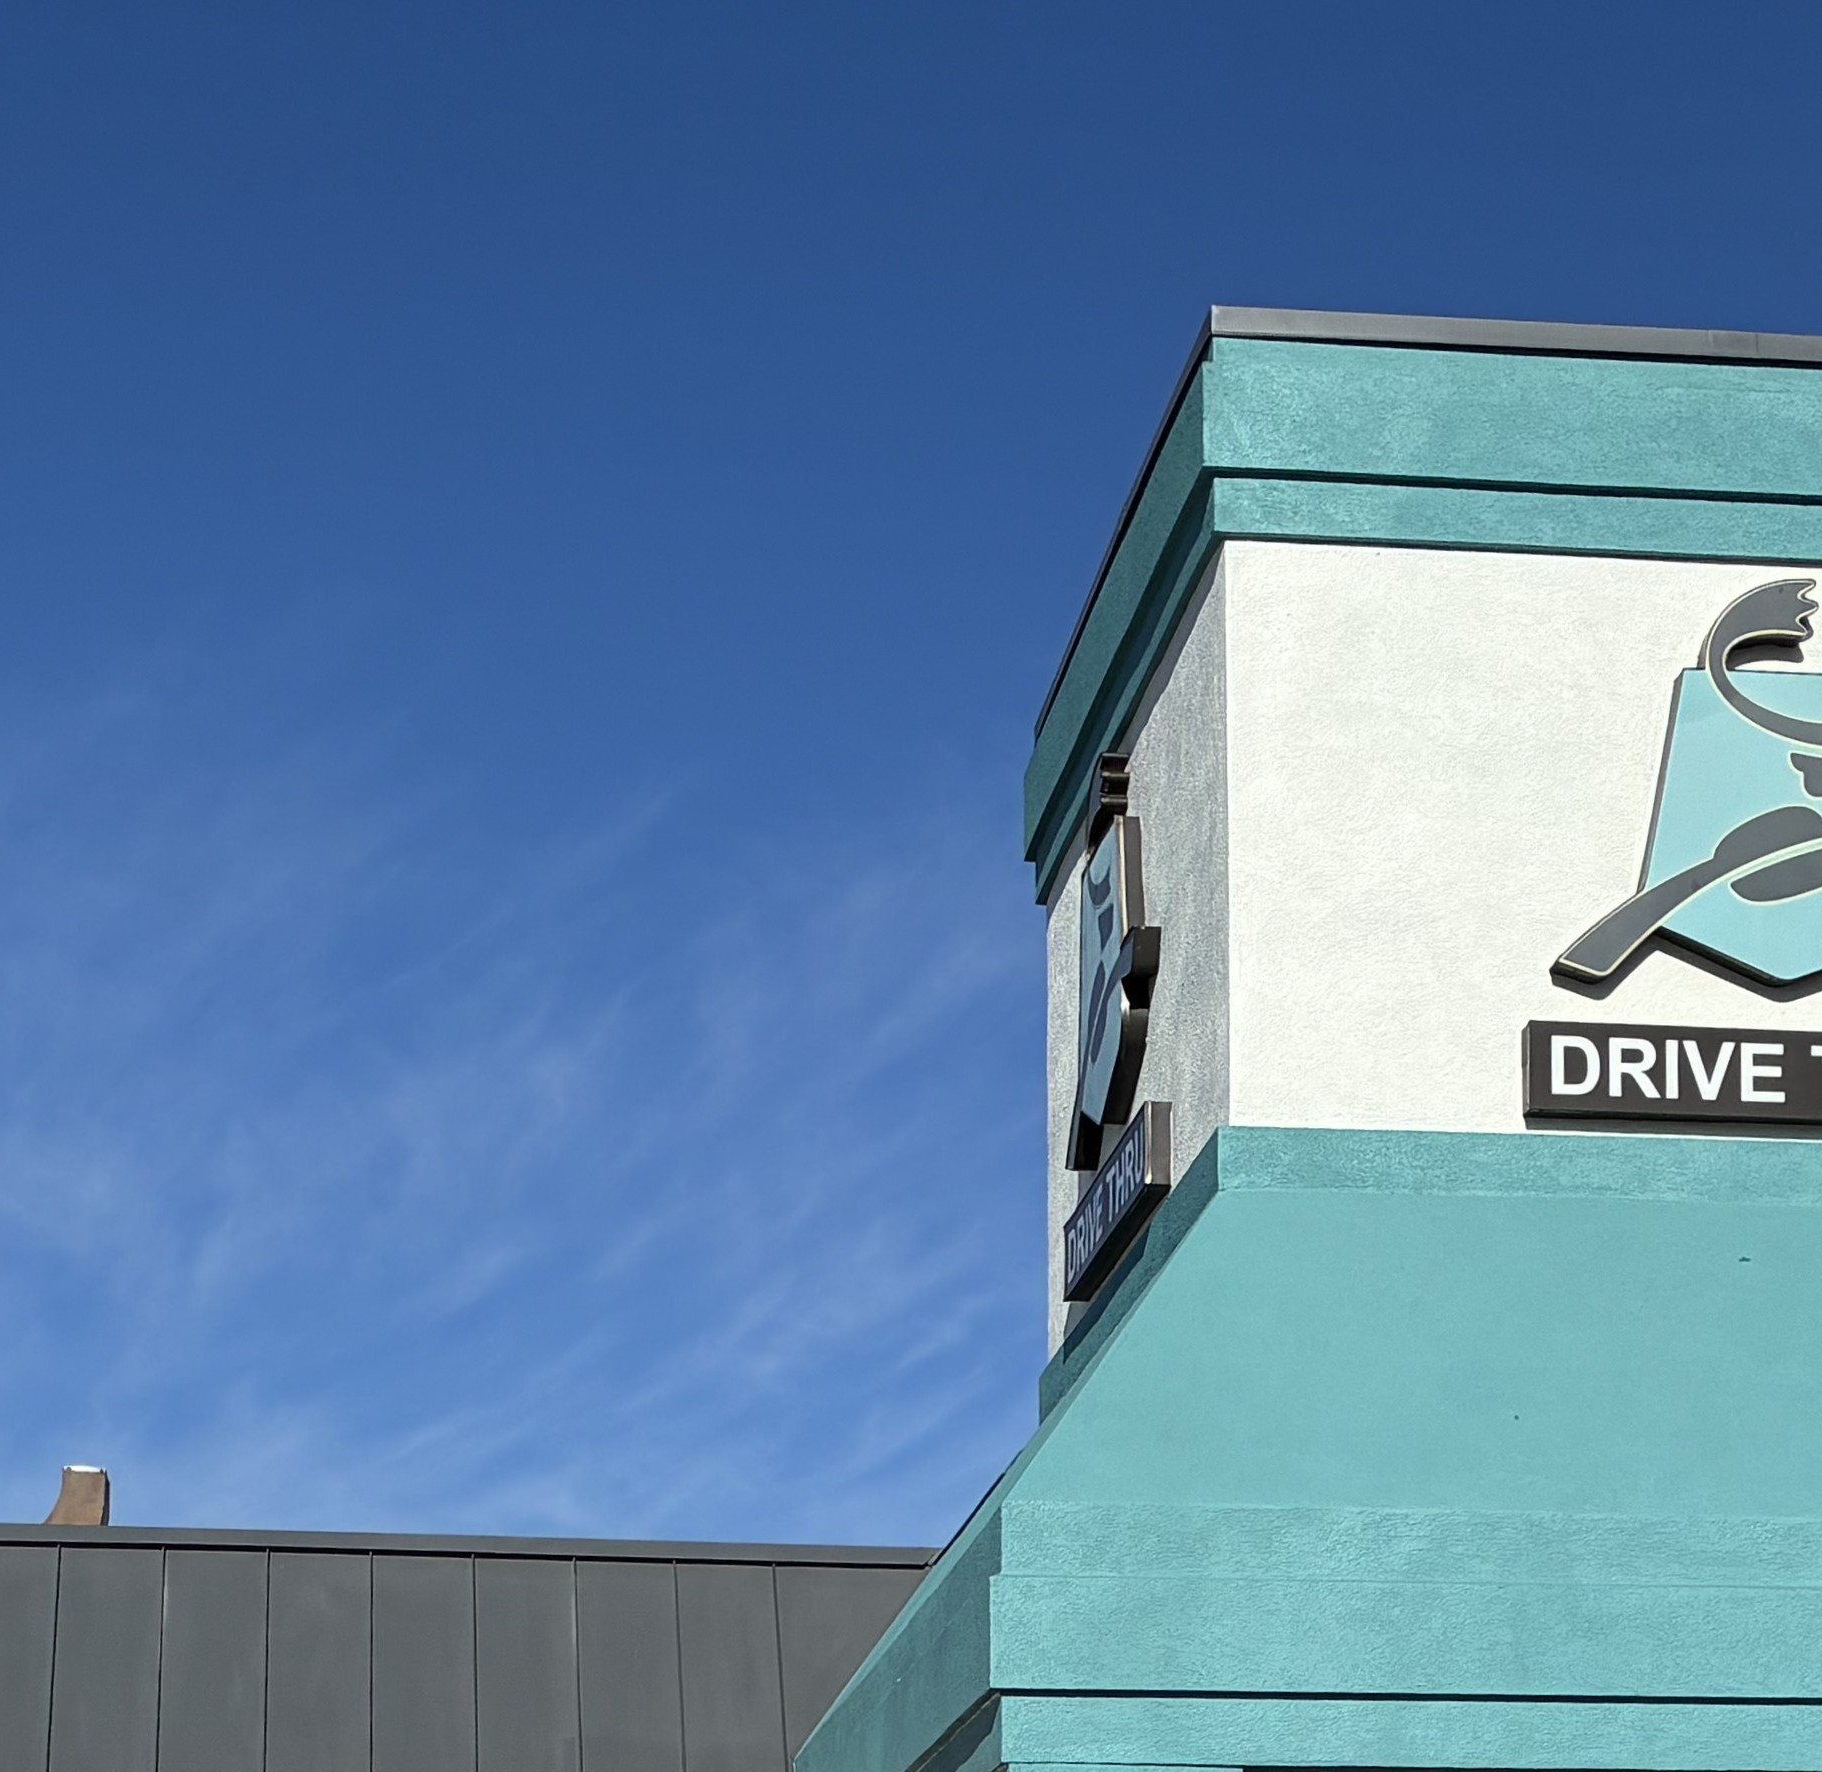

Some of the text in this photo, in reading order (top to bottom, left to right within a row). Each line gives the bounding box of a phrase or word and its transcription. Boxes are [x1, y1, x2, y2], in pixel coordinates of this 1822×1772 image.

[1549, 1034, 1786, 1104] DRIVE
[1066, 1120, 1145, 1285] DRIVE THRU
